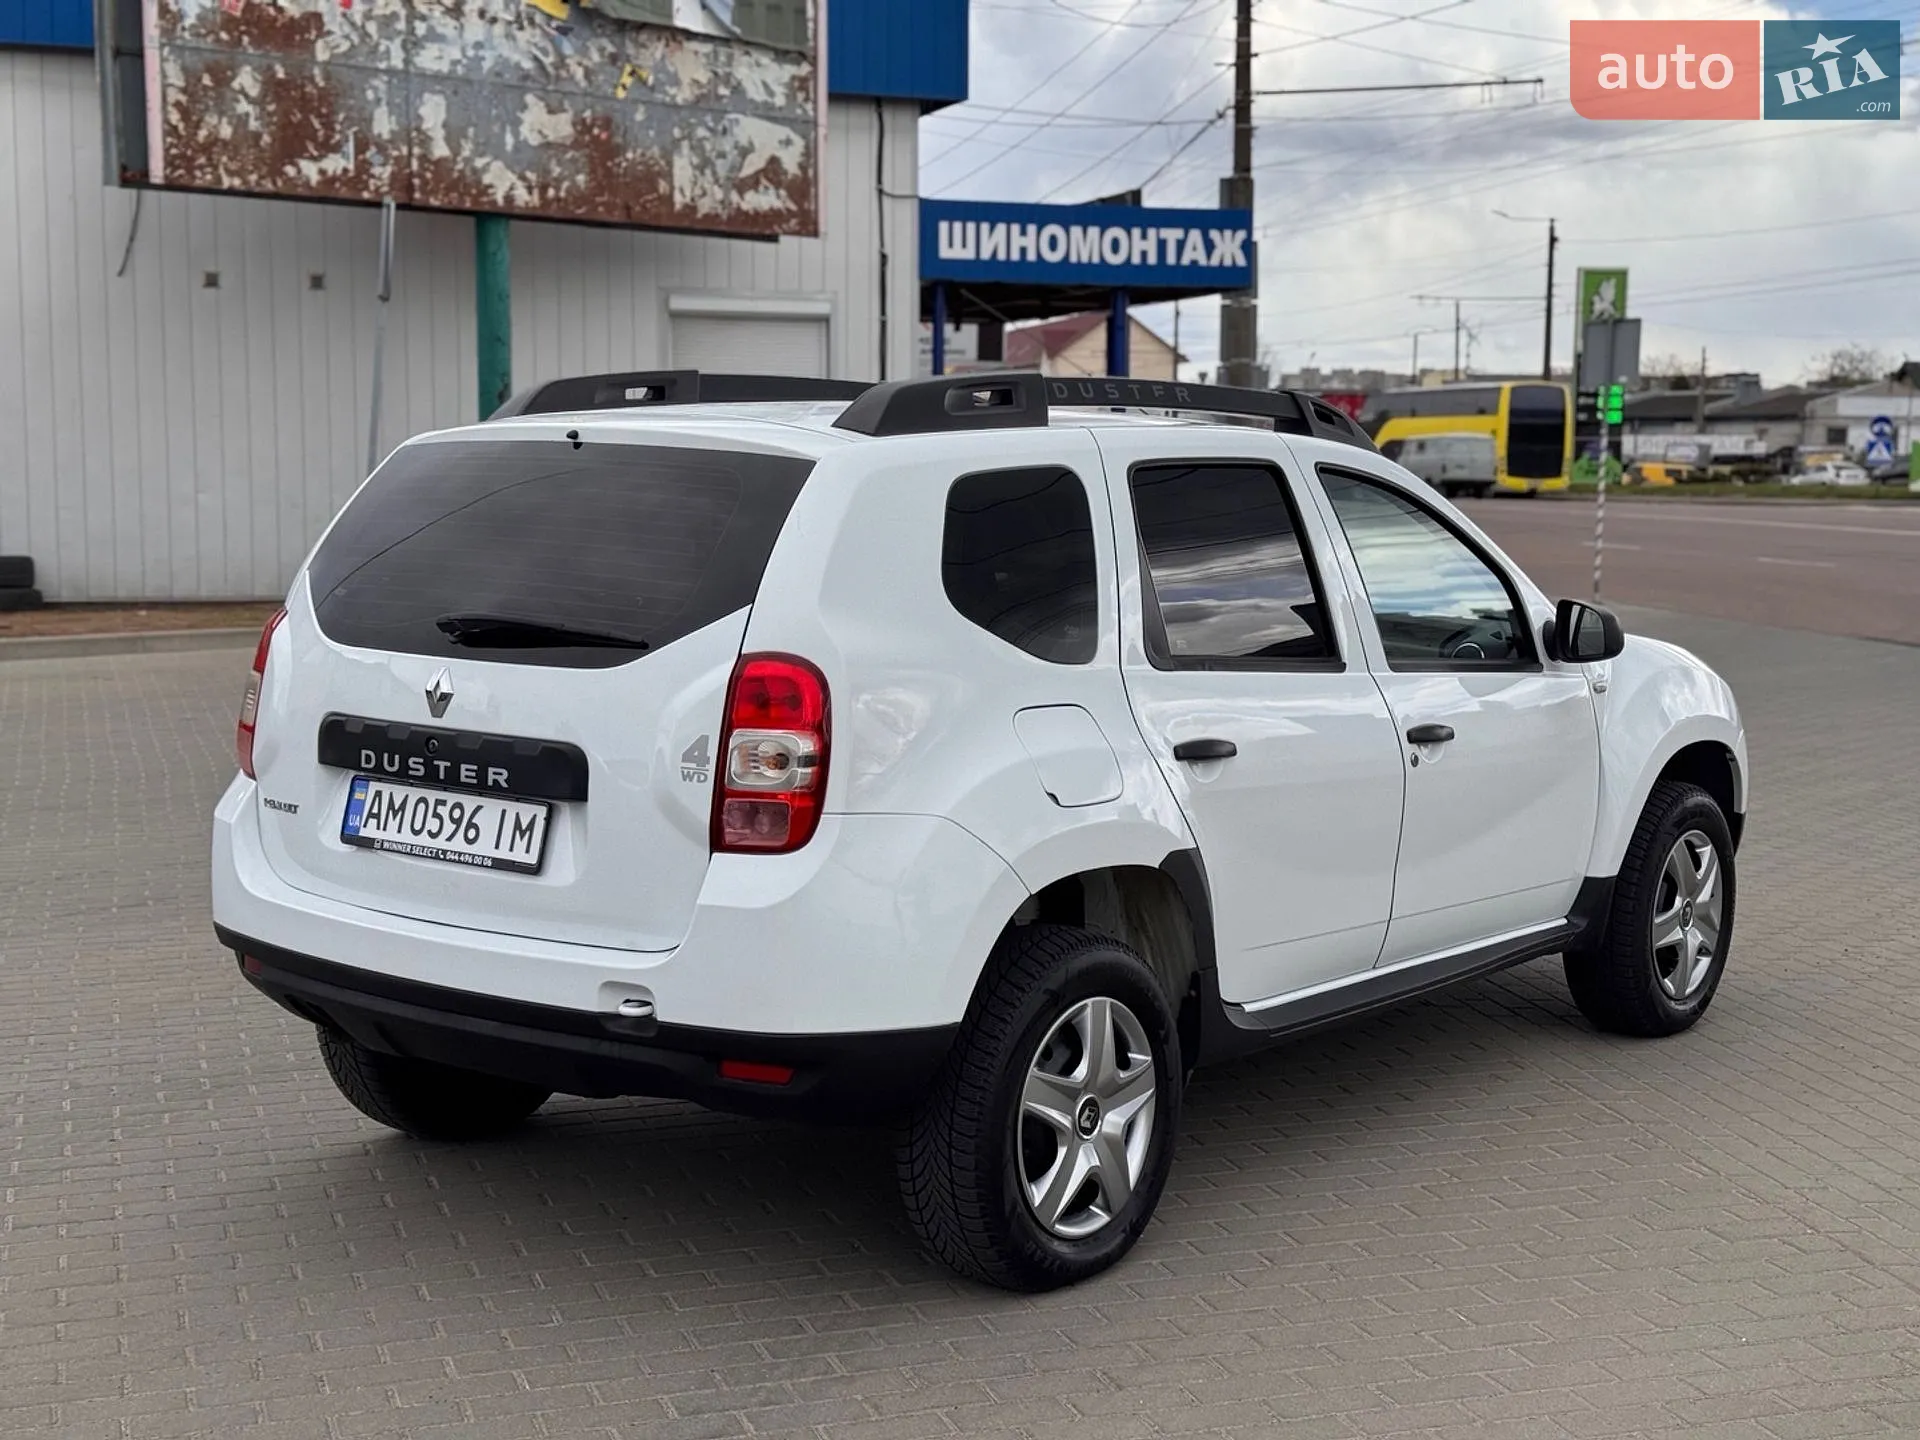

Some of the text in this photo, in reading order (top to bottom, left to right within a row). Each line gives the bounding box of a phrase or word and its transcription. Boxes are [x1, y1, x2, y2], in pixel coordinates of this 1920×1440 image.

[938, 220, 1248, 267] ШИНОМОНТАЖ
[360, 749, 509, 788] DUSTER
[681, 770, 708, 784] WD
[494, 808, 537, 854] IM
[411, 845, 437, 857] SELECT
